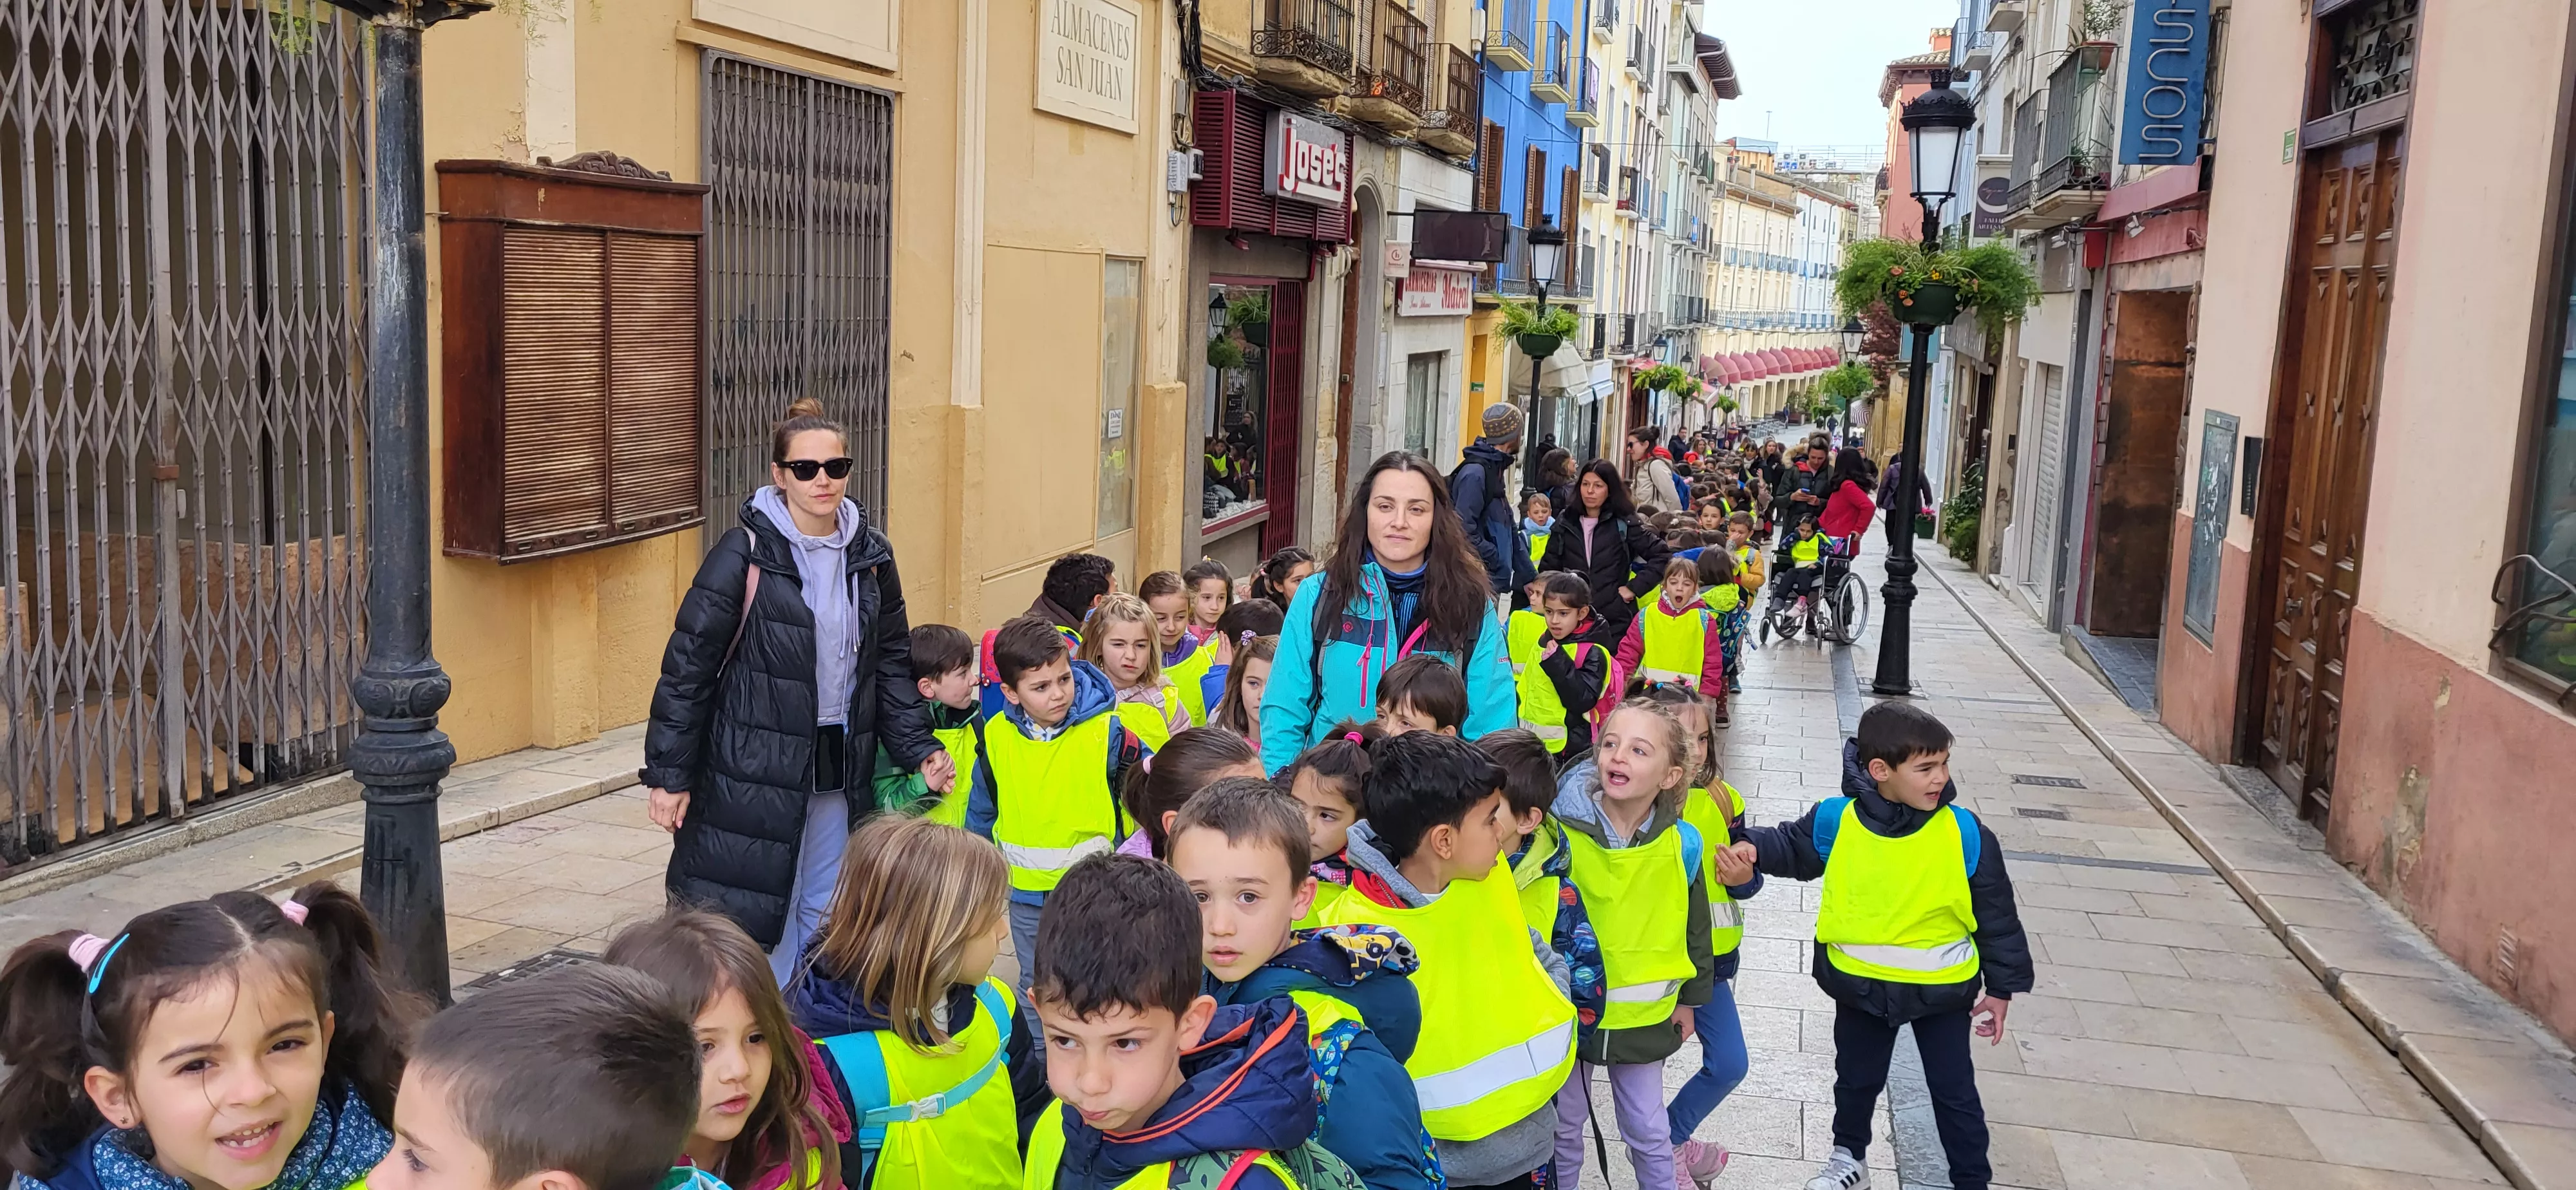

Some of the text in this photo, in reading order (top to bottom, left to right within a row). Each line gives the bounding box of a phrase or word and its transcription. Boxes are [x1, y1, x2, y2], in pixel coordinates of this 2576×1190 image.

[1051, 0, 1130, 61] ALMACENES
[1056, 46, 1123, 102] SAN JUAN
[2138, 0, 2197, 158] SCOS
